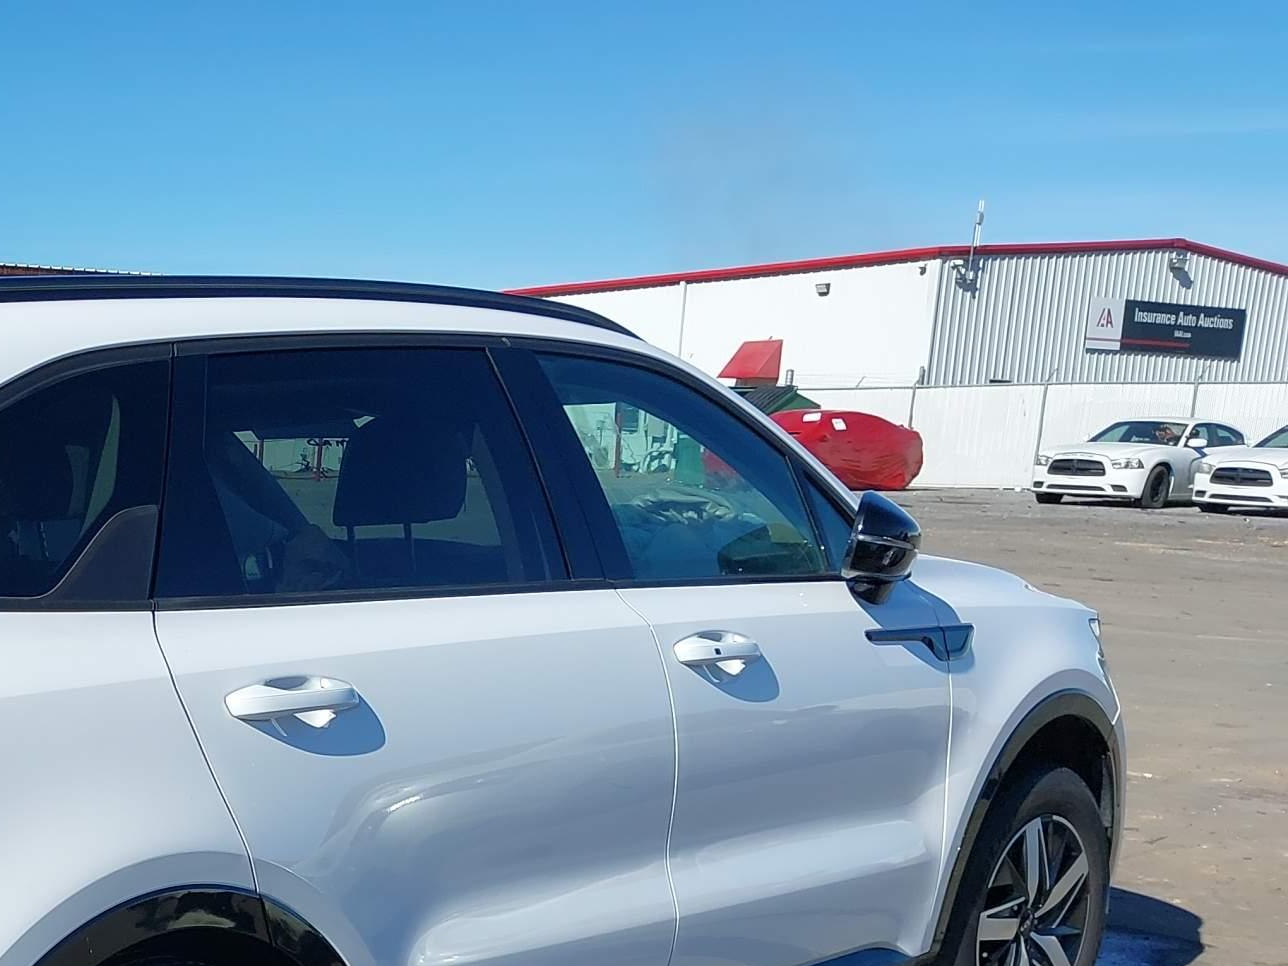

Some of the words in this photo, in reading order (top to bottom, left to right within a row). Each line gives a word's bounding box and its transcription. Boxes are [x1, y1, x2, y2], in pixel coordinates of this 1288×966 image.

[1134, 307, 1176, 325] Insurance
[1176, 311, 1197, 327] Auto
[1197, 313, 1234, 330] Auctions
